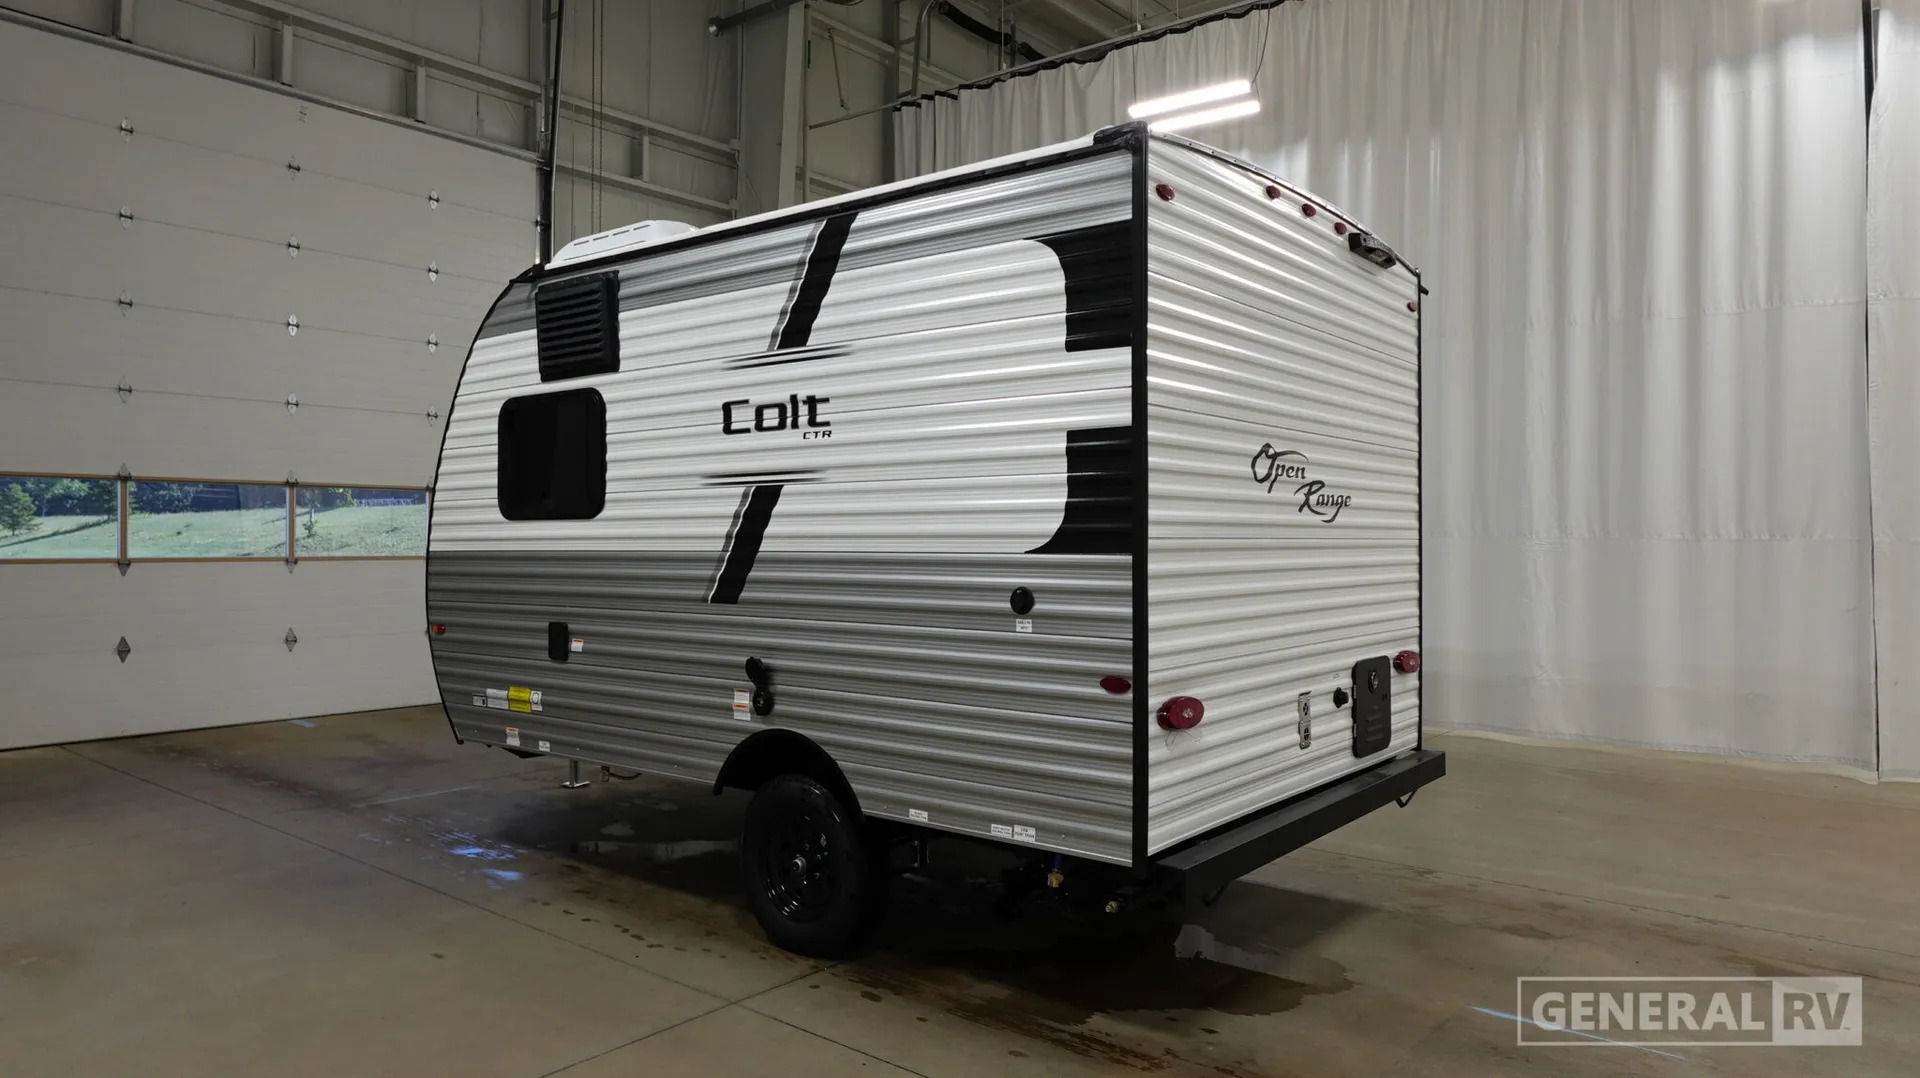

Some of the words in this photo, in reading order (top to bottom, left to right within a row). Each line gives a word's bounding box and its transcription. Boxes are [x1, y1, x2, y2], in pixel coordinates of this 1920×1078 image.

[721, 393, 831, 435] Colt
[802, 430, 832, 440] CTR
[1250, 442, 1309, 494] Open
[1293, 480, 1352, 524] Range
